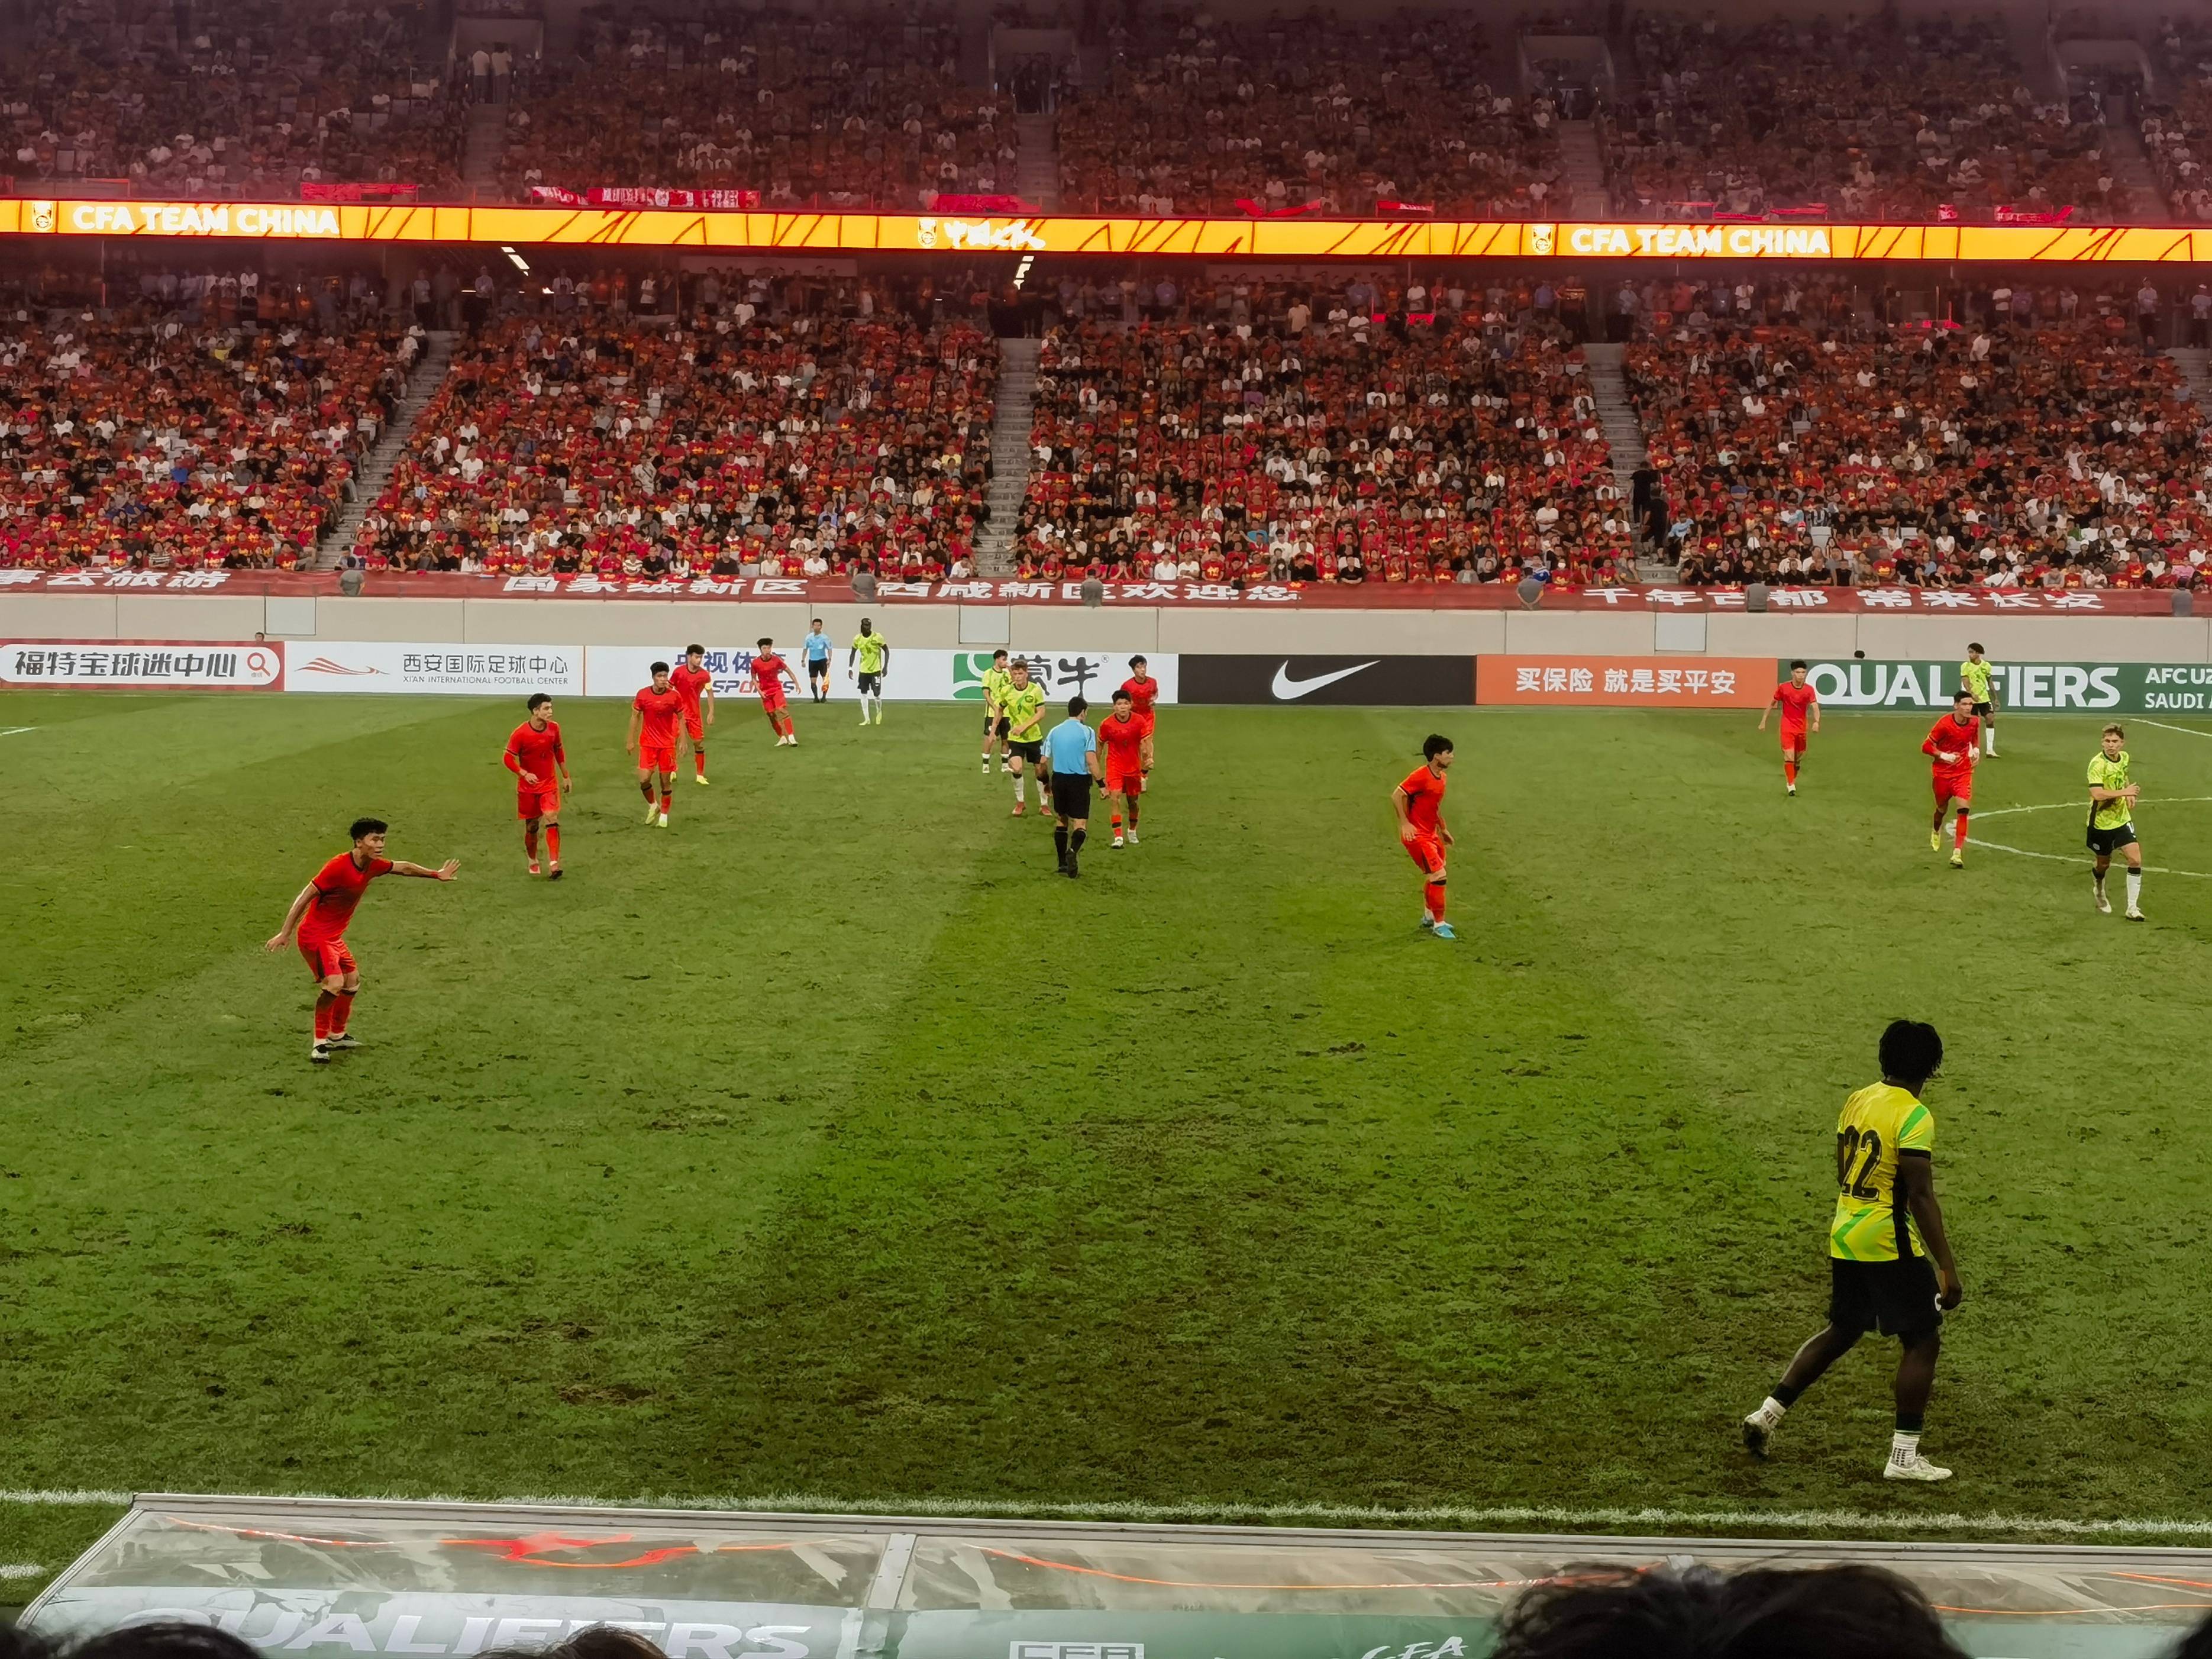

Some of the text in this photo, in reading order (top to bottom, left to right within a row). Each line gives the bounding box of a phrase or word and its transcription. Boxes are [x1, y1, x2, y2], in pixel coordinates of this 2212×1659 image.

[73, 205, 339, 234] CFA TEAM CHINA
[1571, 228, 1830, 254] CFA TEAM CHINA
[15, 651, 237, 677] 福特宝球迷中心
[403, 654, 568, 674] 西安国际足球中心
[2145, 667, 2187, 684] AFC
[494, 676, 534, 685] FOOTBALL
[712, 680, 795, 693] SPOS
[1516, 667, 1735, 695] 买保险 就是买平安
[1806, 664, 2121, 708] QUALIERS
[2145, 692, 2204, 709] SAUDI
